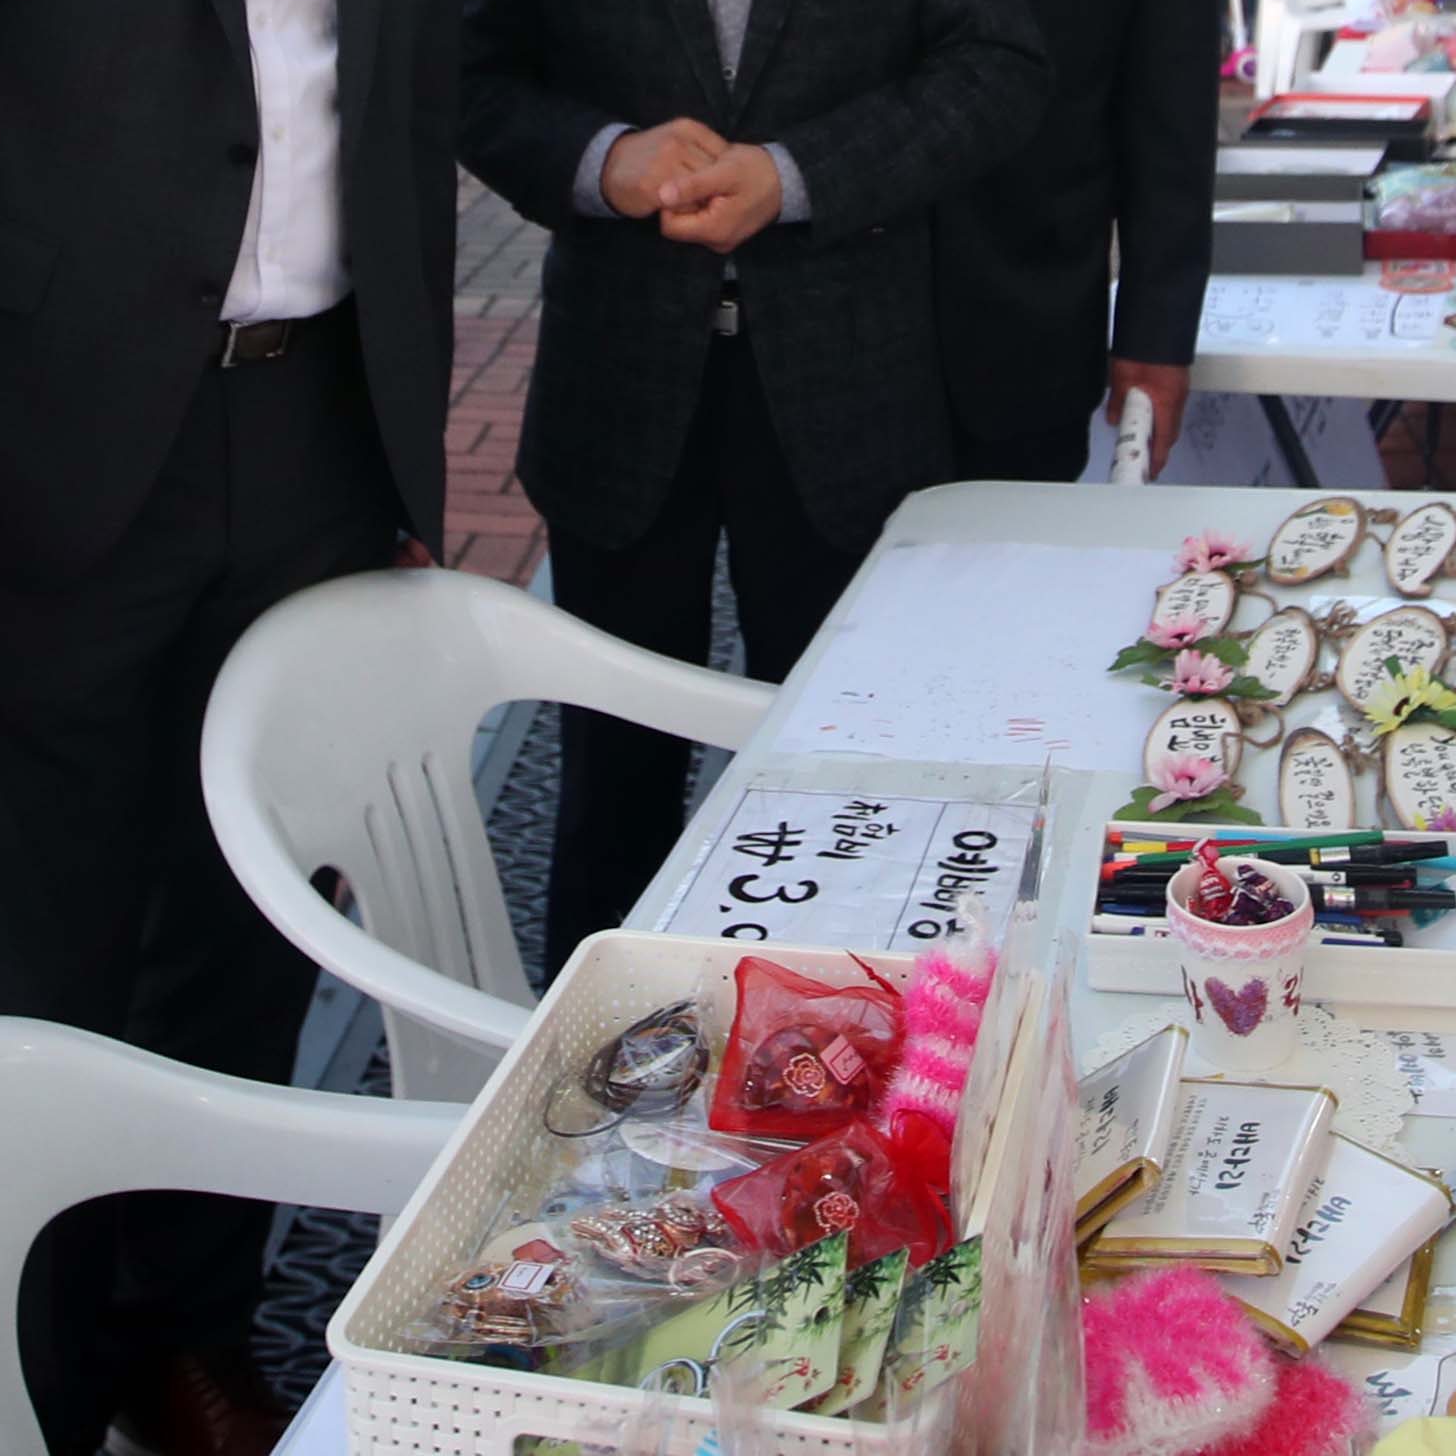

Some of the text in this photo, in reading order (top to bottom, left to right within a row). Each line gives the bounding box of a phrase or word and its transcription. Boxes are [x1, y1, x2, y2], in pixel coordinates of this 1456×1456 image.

[816, 800, 901, 860] 체험비
[1213, 1121, 1261, 1190] 배다리
[1285, 1195, 1353, 1265] 배다리
